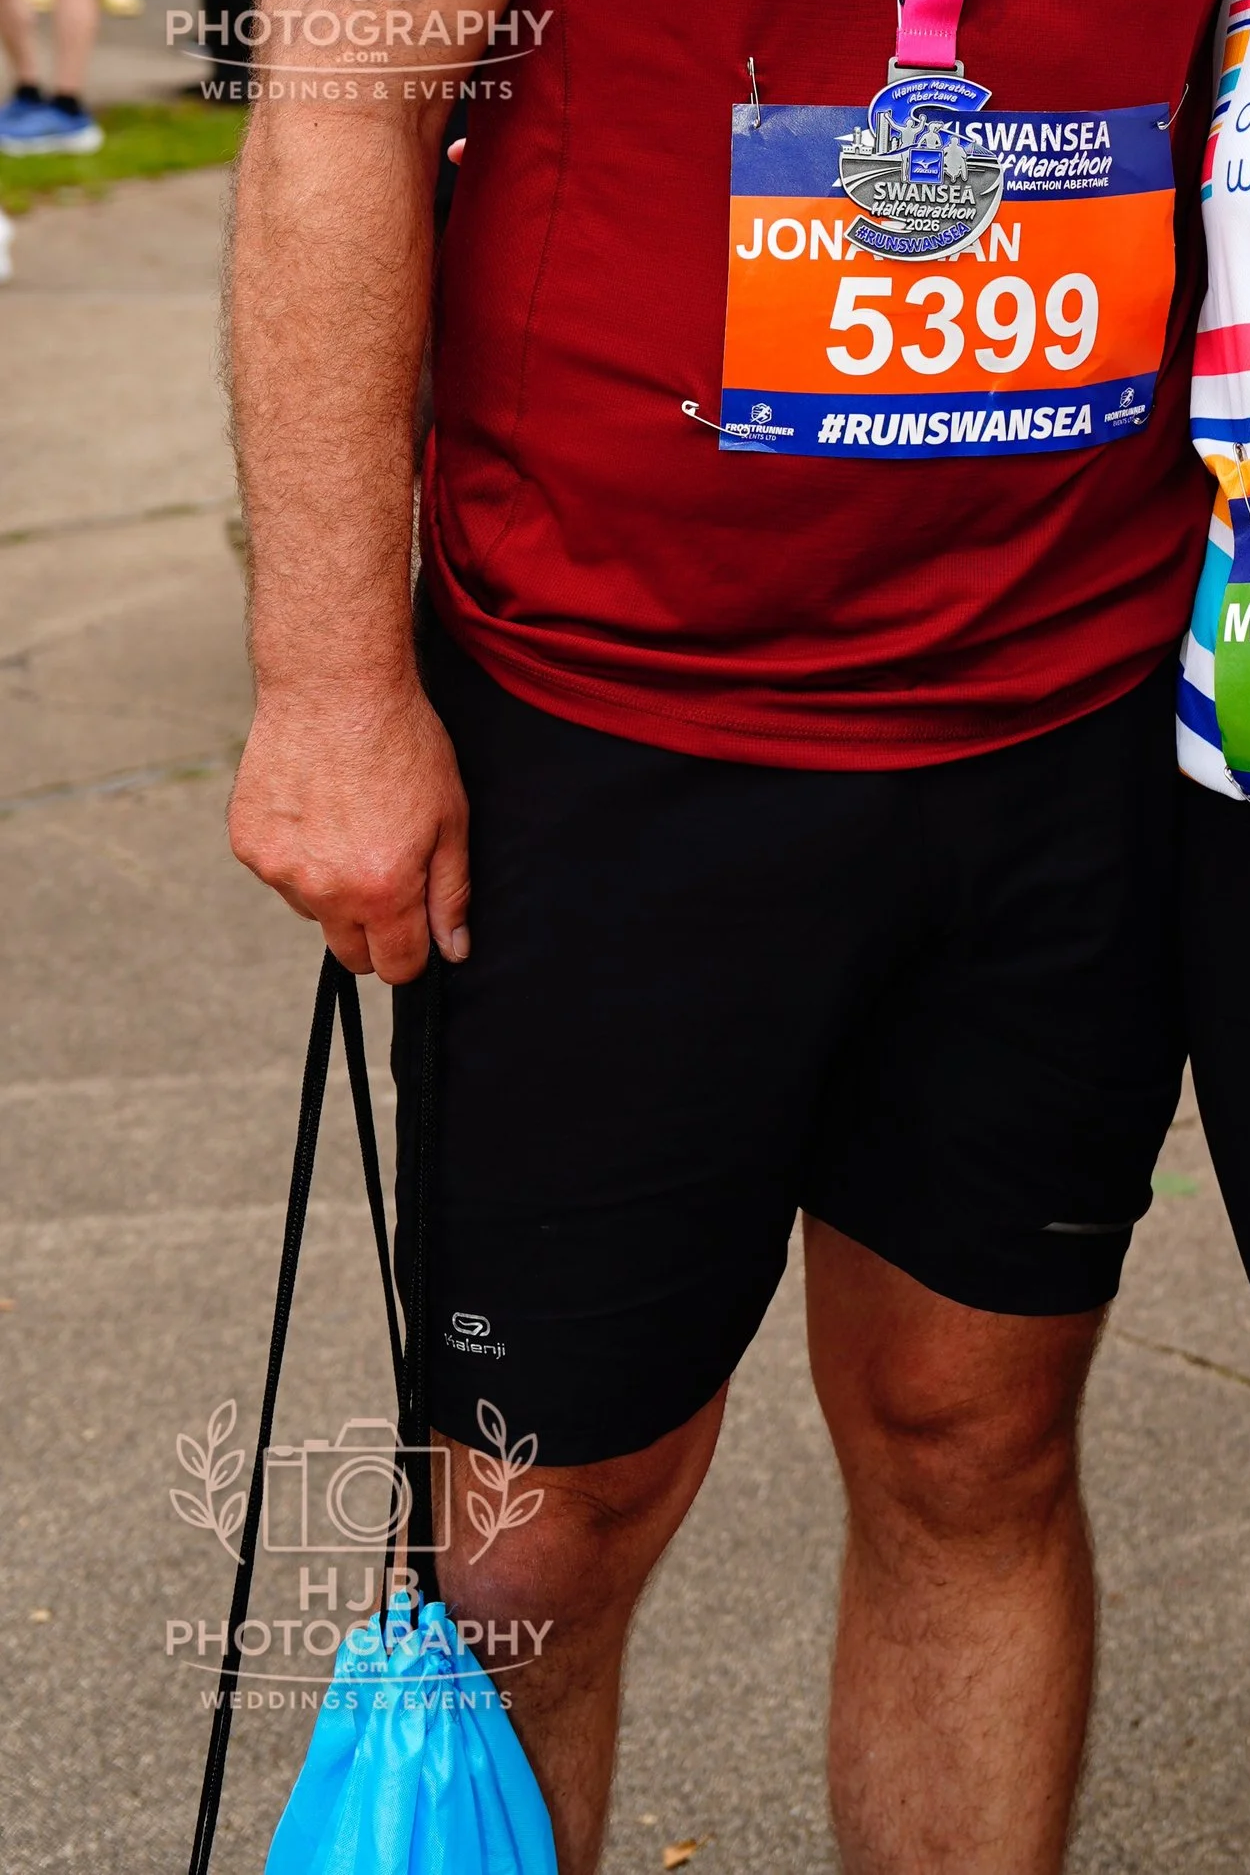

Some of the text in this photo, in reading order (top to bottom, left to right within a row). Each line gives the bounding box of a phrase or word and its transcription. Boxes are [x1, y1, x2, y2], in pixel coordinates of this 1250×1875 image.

[892, 81, 977, 100] Hanner Marathon
[907, 91, 958, 104] Abertawe
[964, 120, 1111, 152] SWANSEA
[873, 181, 976, 205] SWANSEA
[1006, 177, 1109, 191] MARATHON ABERTAWE
[855, 221, 972, 254] #RUNSWANSEA
[905, 218, 940, 232] 2026
[825, 272, 1100, 376] 5399
[817, 403, 1093, 447] #RUNSWANSEA
[444, 1332, 505, 1360] Kalenji
